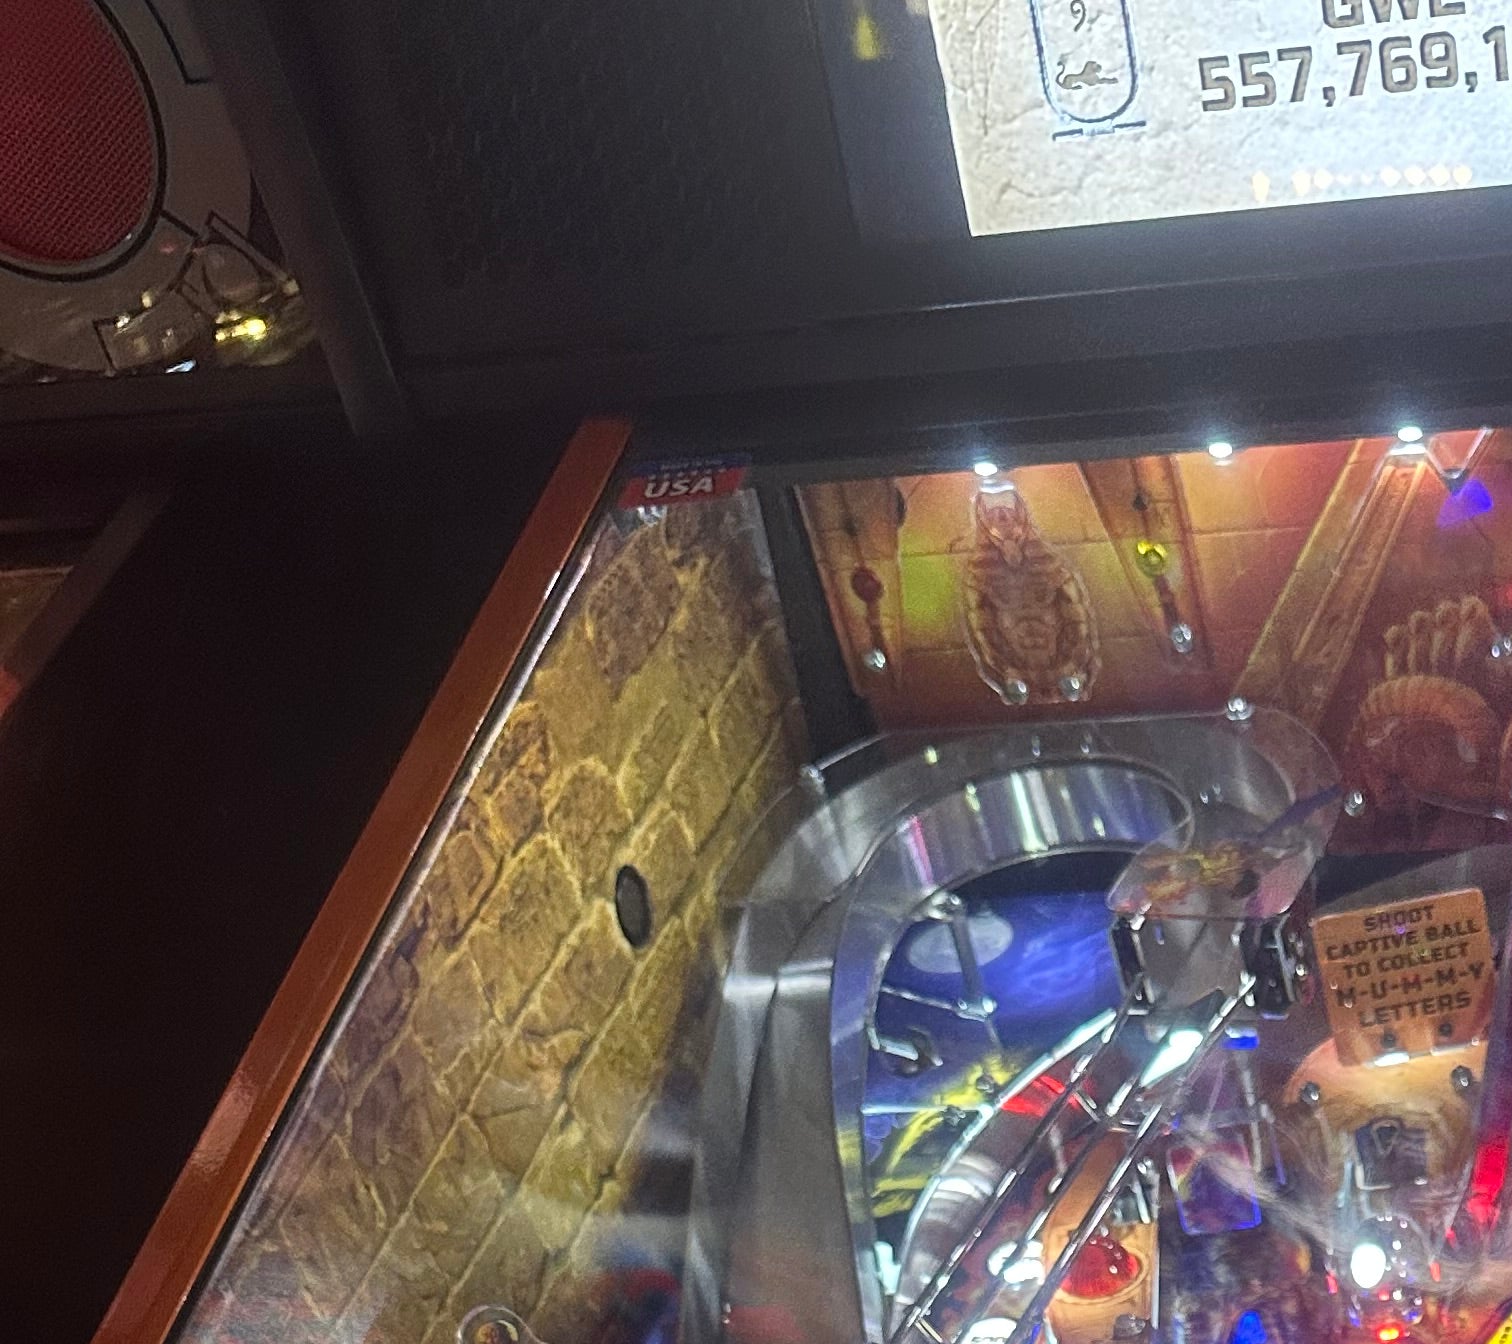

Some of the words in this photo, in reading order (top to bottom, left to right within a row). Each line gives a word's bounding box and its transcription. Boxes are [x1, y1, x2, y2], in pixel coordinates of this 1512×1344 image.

[644, 475, 714, 498] USA
[1364, 905, 1435, 933] SHOOT
[1325, 930, 1419, 962] CAPTIVE
[1425, 919, 1481, 948] BALL
[1344, 959, 1372, 980] TO
[1377, 942, 1471, 973] COLLECT
[1336, 961, 1486, 1006] M-U-M-M-Y
[1359, 990, 1473, 1028] LETTERS
